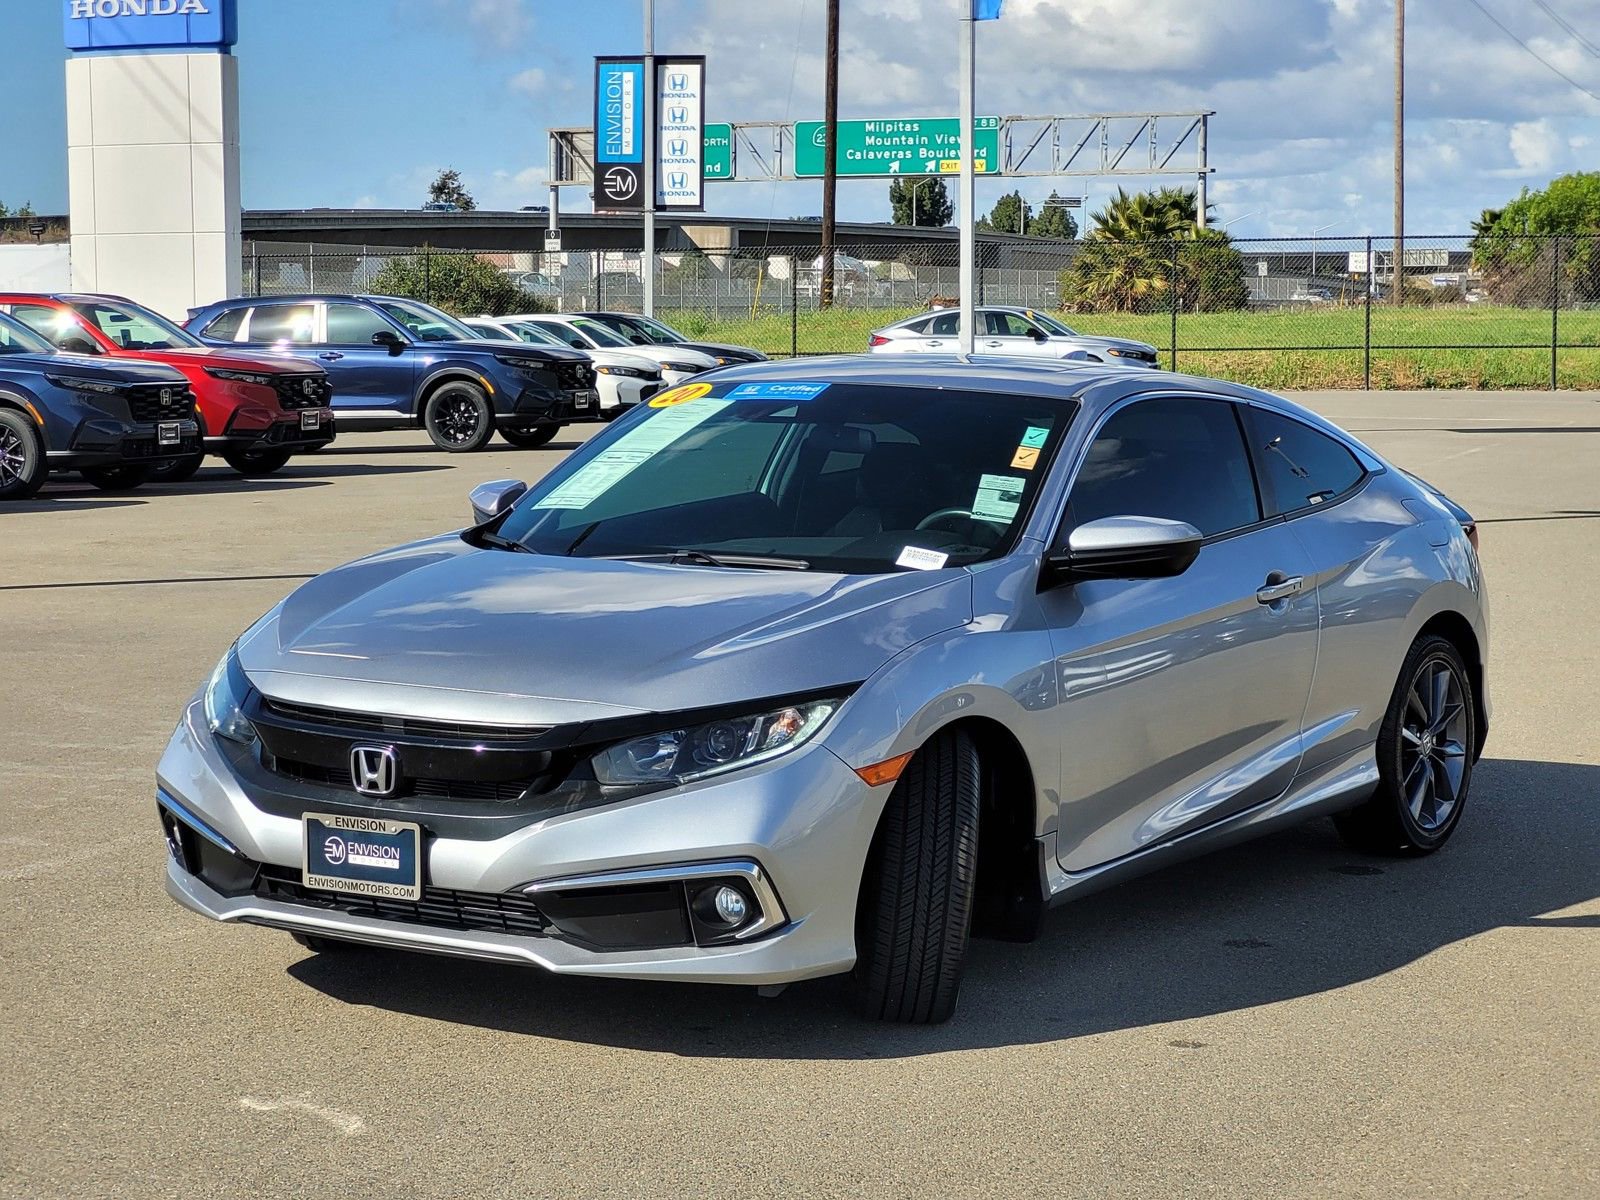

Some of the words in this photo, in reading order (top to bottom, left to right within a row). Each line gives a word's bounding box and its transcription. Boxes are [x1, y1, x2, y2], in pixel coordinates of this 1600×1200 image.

[70, 0, 209, 18] HONDA
[606, 71, 622, 155] ENVISION
[865, 121, 920, 132] Milpitas
[704, 138, 729, 146] ORTH
[865, 135, 929, 146] Mountain
[846, 149, 912, 160] Calaveras
[919, 147, 987, 158] Boulerd
[770, 384, 822, 393] Certified
[335, 816, 386, 832] ENVISION
[347, 842, 400, 860] ENVISION
[308, 876, 415, 898] ENVISIONMOTORS.COM
